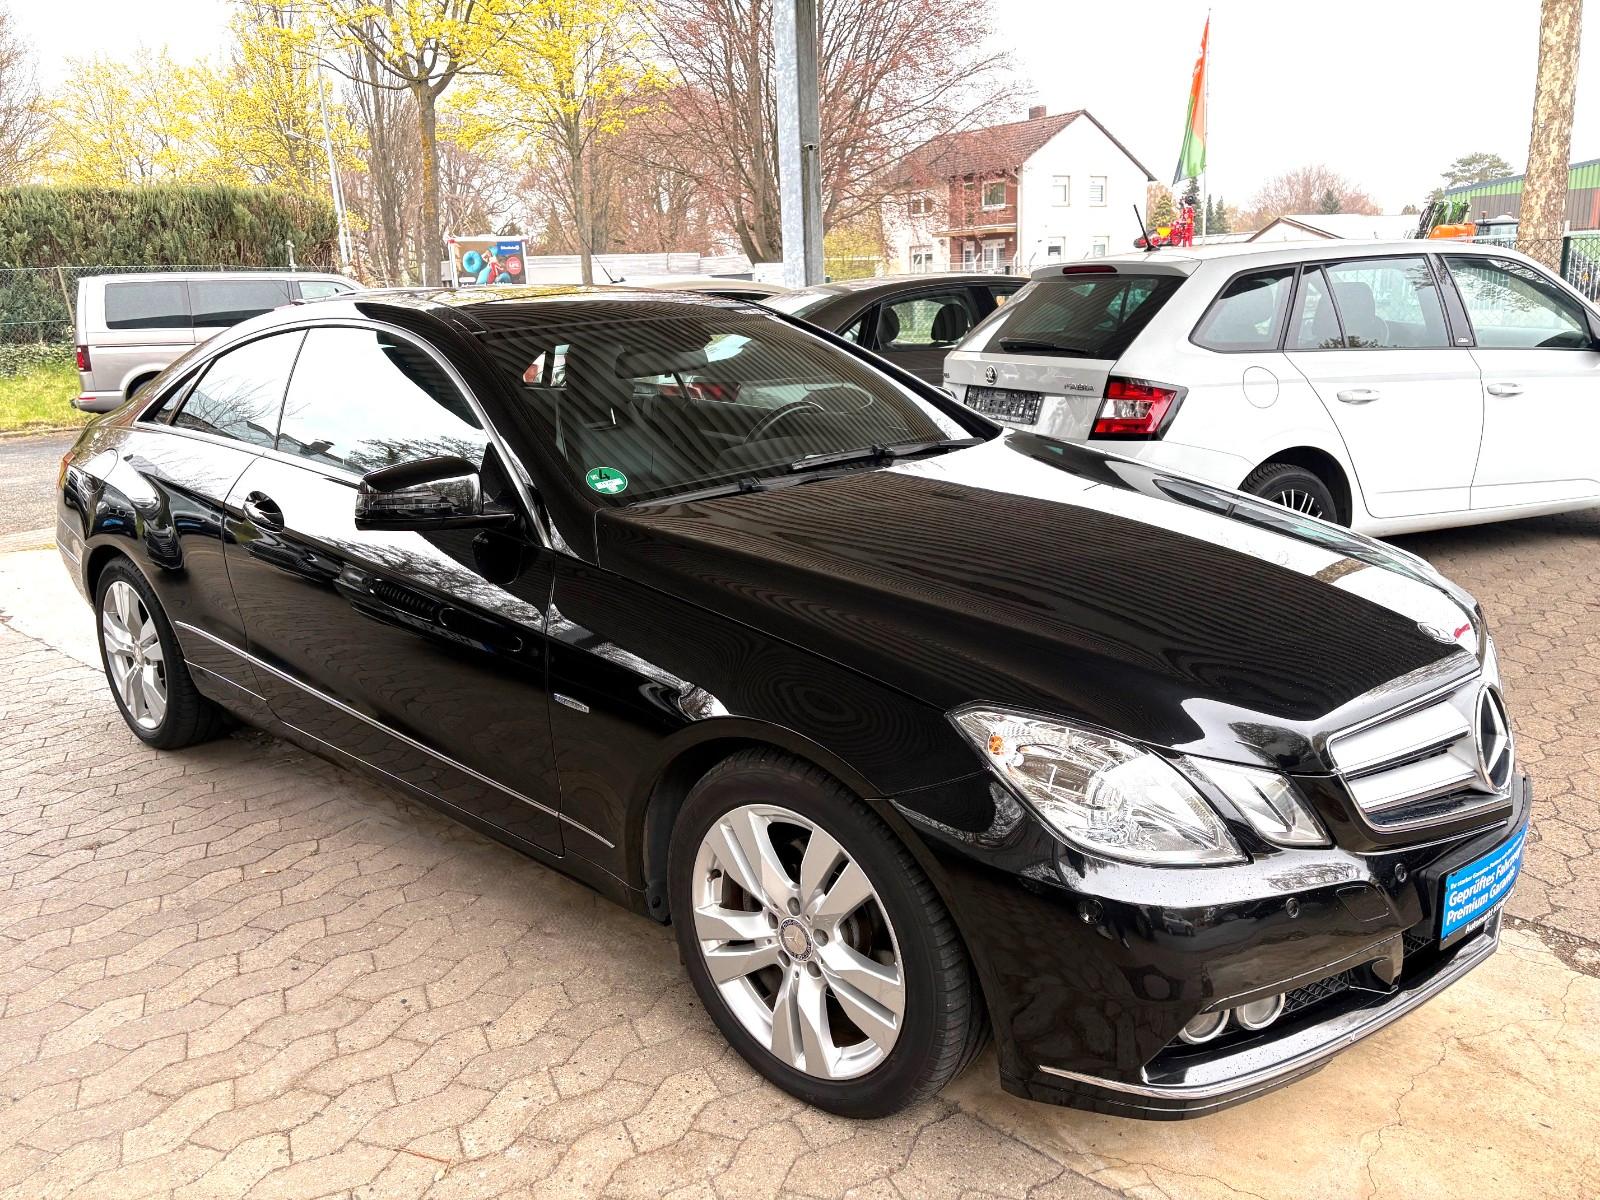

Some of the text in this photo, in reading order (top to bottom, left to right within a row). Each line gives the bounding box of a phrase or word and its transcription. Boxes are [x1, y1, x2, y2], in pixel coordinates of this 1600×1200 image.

[1063, 383, 1095, 392] FABIA
[1446, 893, 1489, 926] Premium
[1489, 865, 1516, 898] Garantie
[1449, 871, 1495, 907] Geprüftes
